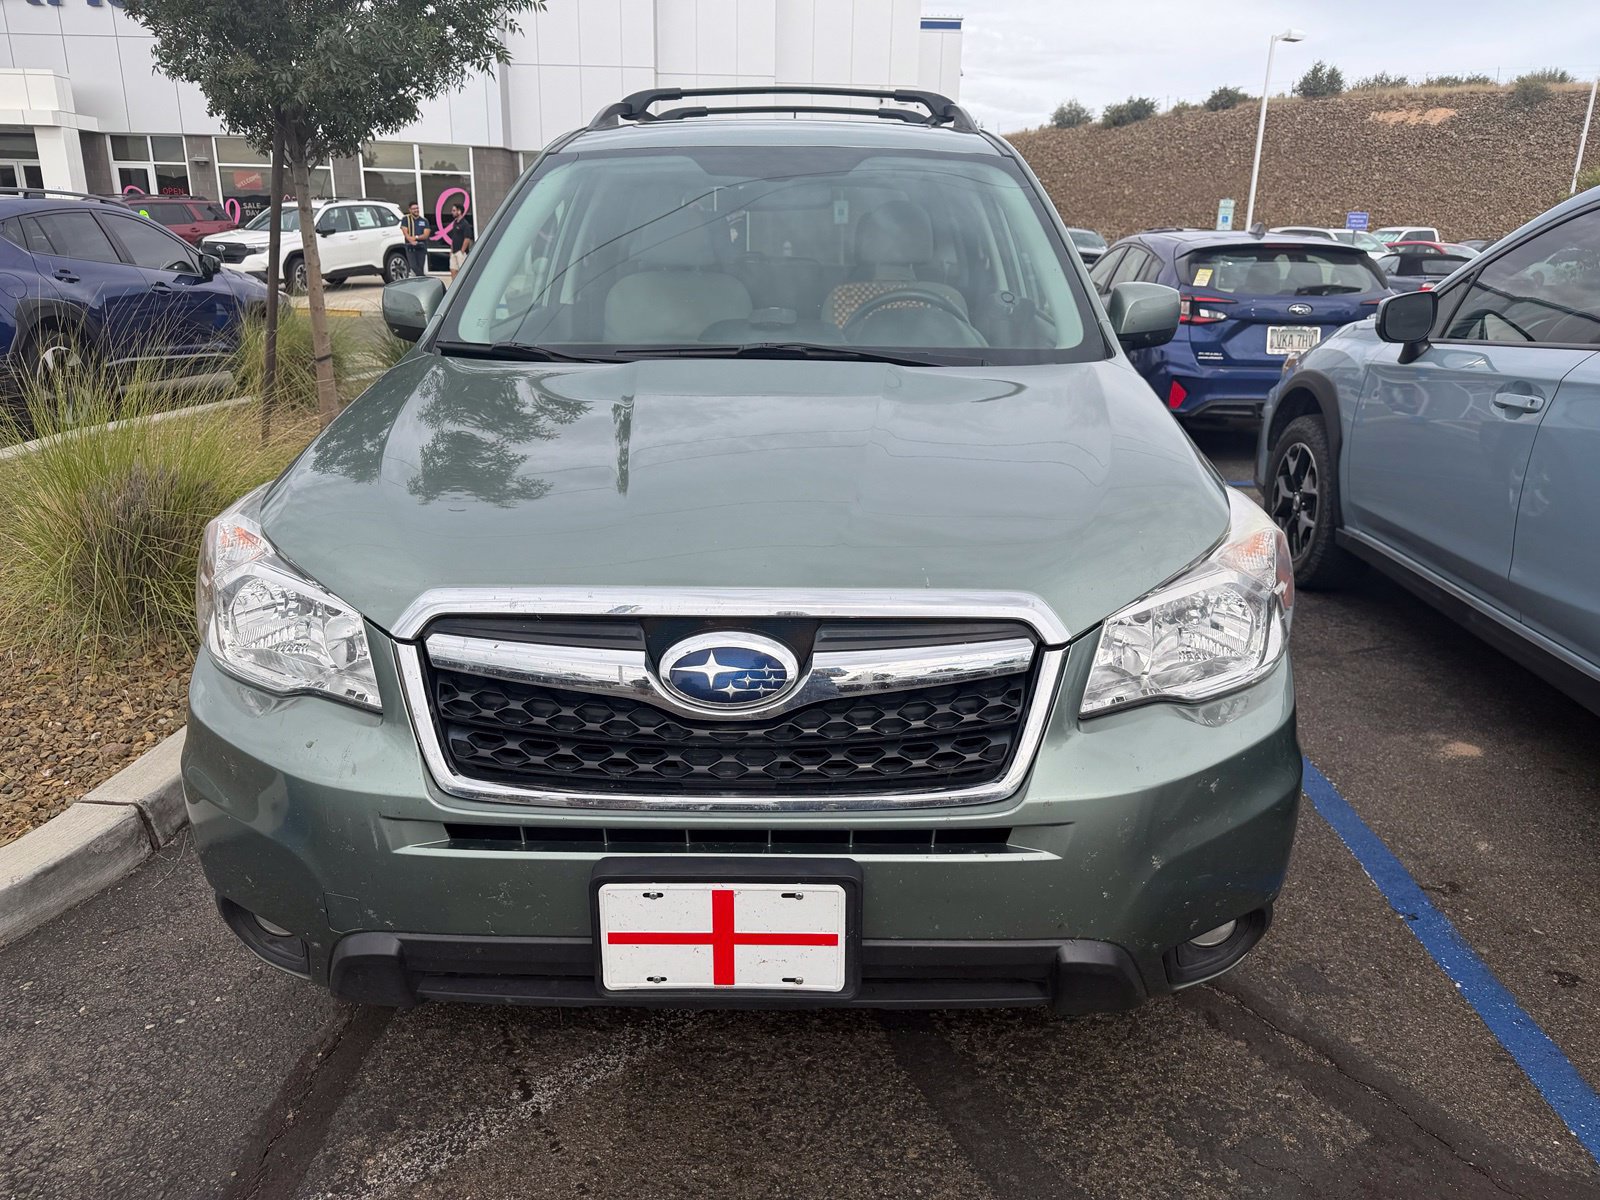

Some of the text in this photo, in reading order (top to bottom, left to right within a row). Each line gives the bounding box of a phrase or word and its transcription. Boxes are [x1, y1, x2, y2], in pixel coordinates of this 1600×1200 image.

[235, 173, 260, 188] WELCOME
[162, 187, 184, 195] OPEN
[245, 209, 260, 217] DAY
